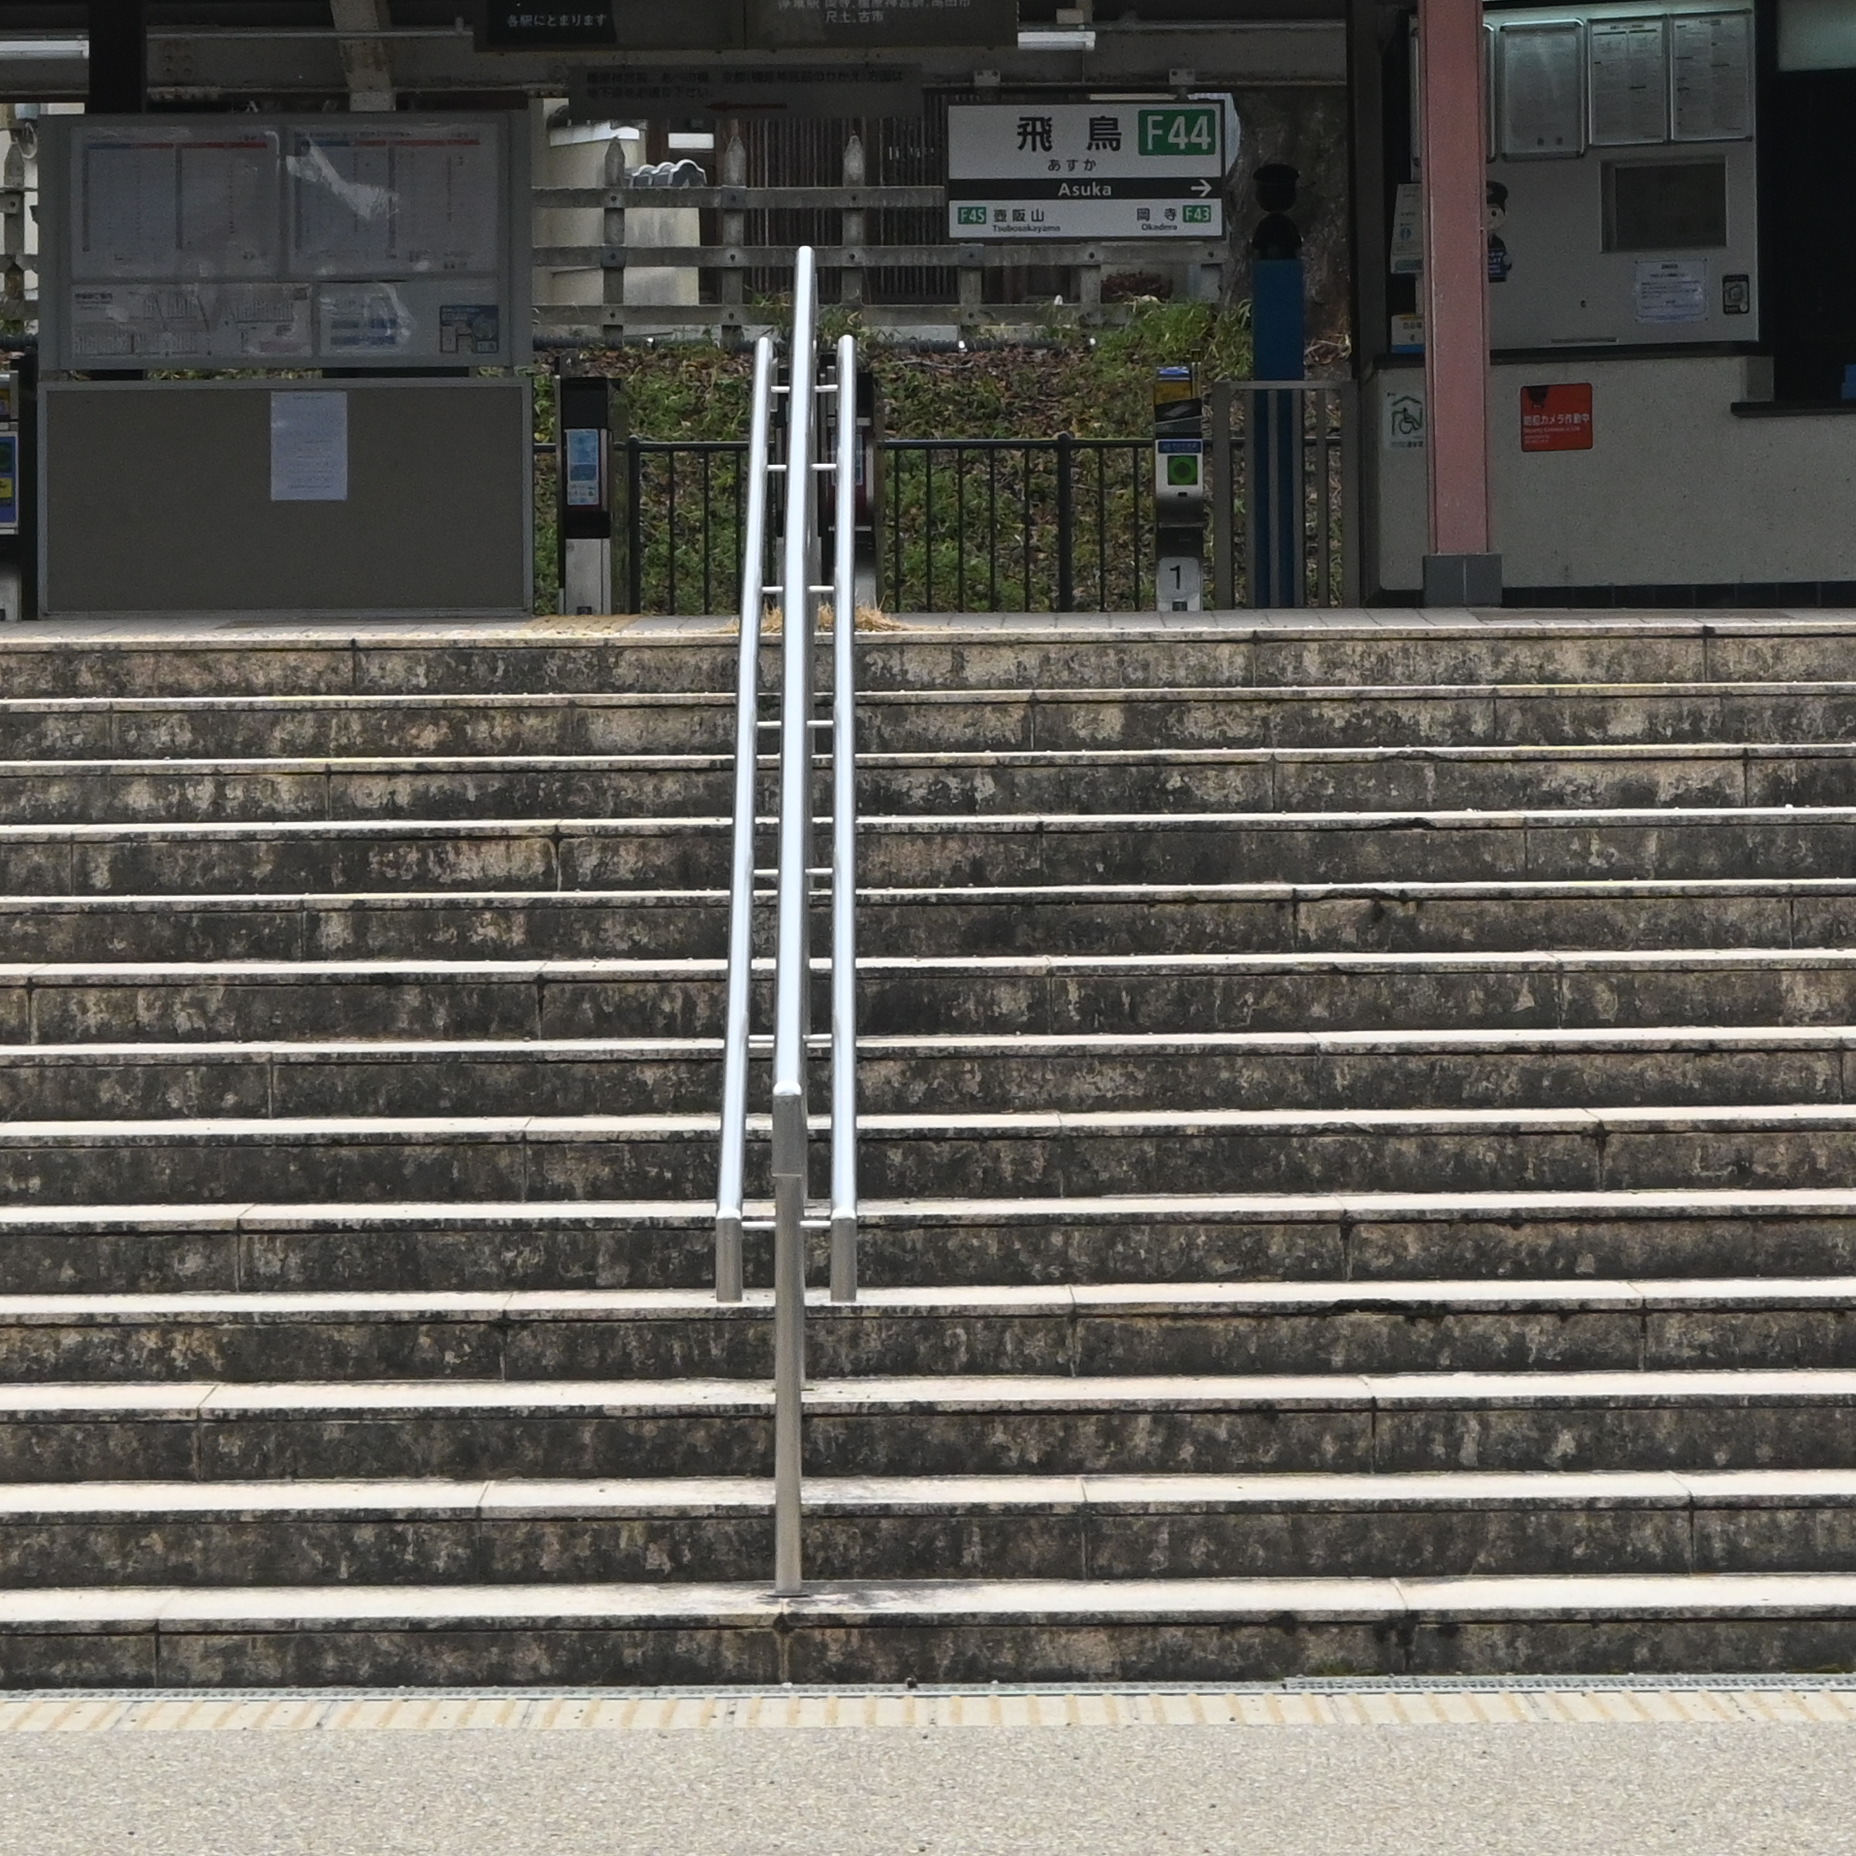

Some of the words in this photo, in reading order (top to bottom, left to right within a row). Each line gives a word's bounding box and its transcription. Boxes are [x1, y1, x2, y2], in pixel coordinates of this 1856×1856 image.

[507, 13, 606, 28] 各駅にとまります
[1016, 115, 1123, 153] 飛鳥
[1146, 115, 1212, 151] F44
[1047, 158, 1098, 173] あすか
[1057, 181, 1113, 198] Asuka
[959, 208, 986, 224] F45
[1136, 207, 1178, 222] 岡寺
[1185, 207, 1211, 222] F43
[993, 224, 1062, 234] Tsubosakayama
[1141, 223, 1179, 232] Okadera
[1169, 565, 1181, 590] 1
